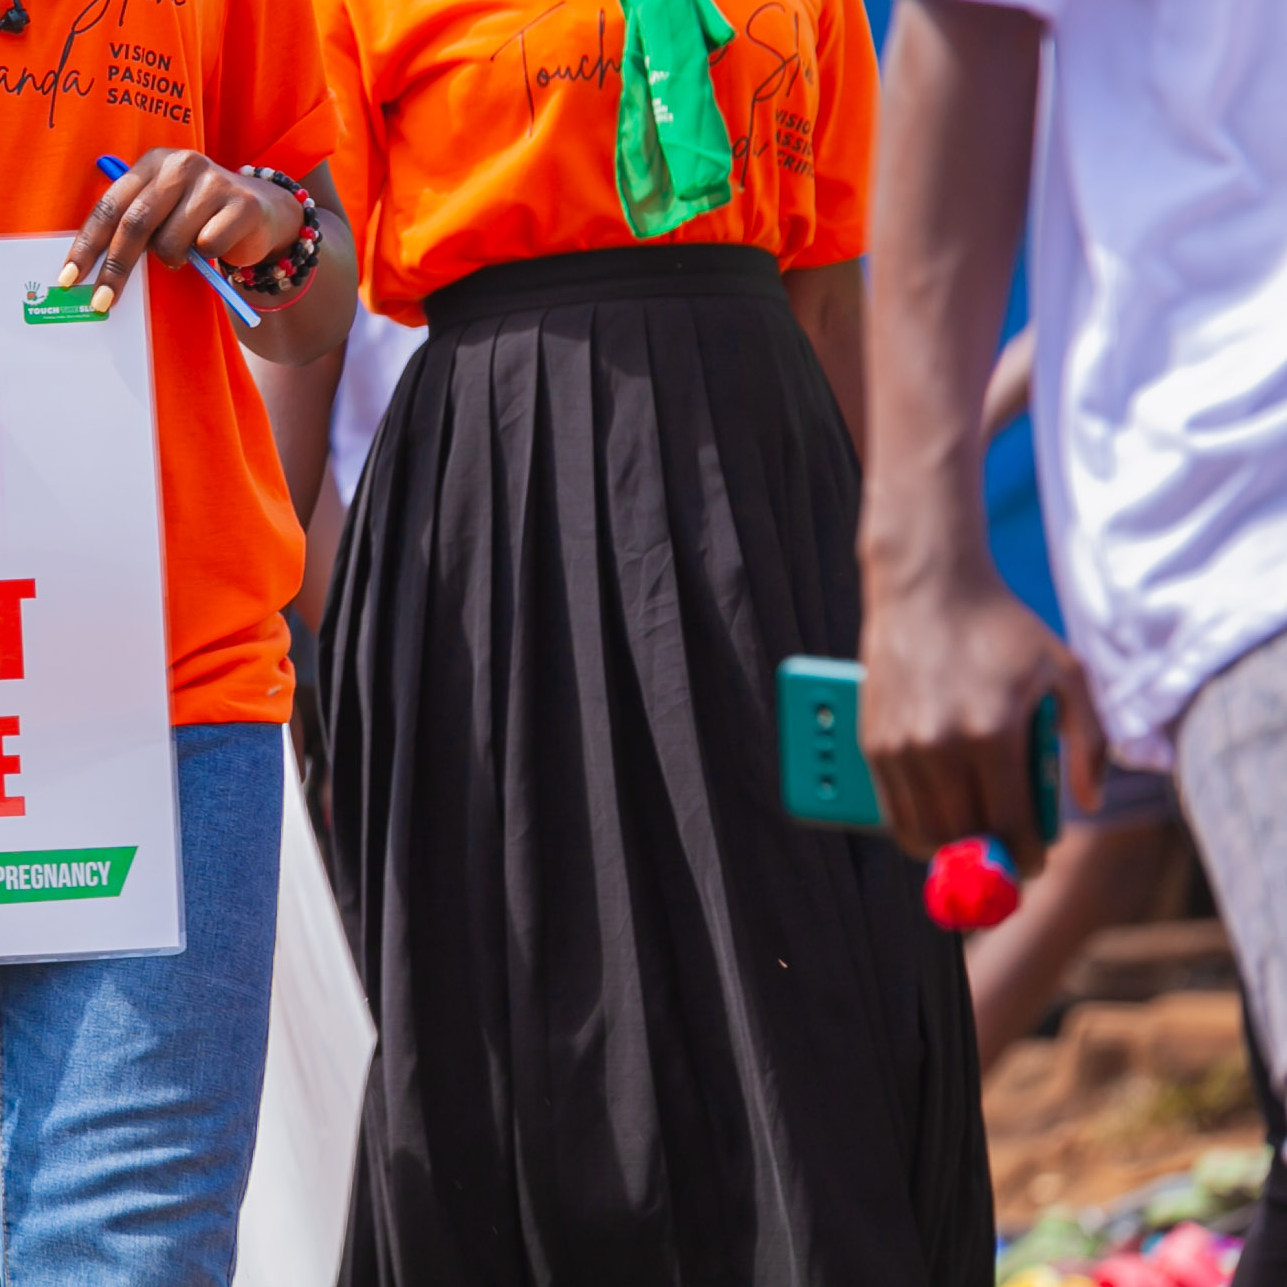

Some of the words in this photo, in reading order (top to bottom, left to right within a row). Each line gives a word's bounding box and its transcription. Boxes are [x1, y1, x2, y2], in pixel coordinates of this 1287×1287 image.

[109, 42, 173, 71] VISION
[107, 65, 186, 99] PASSION
[106, 87, 192, 125] SACRIFICE
[28, 306, 60, 315] TOUCH
